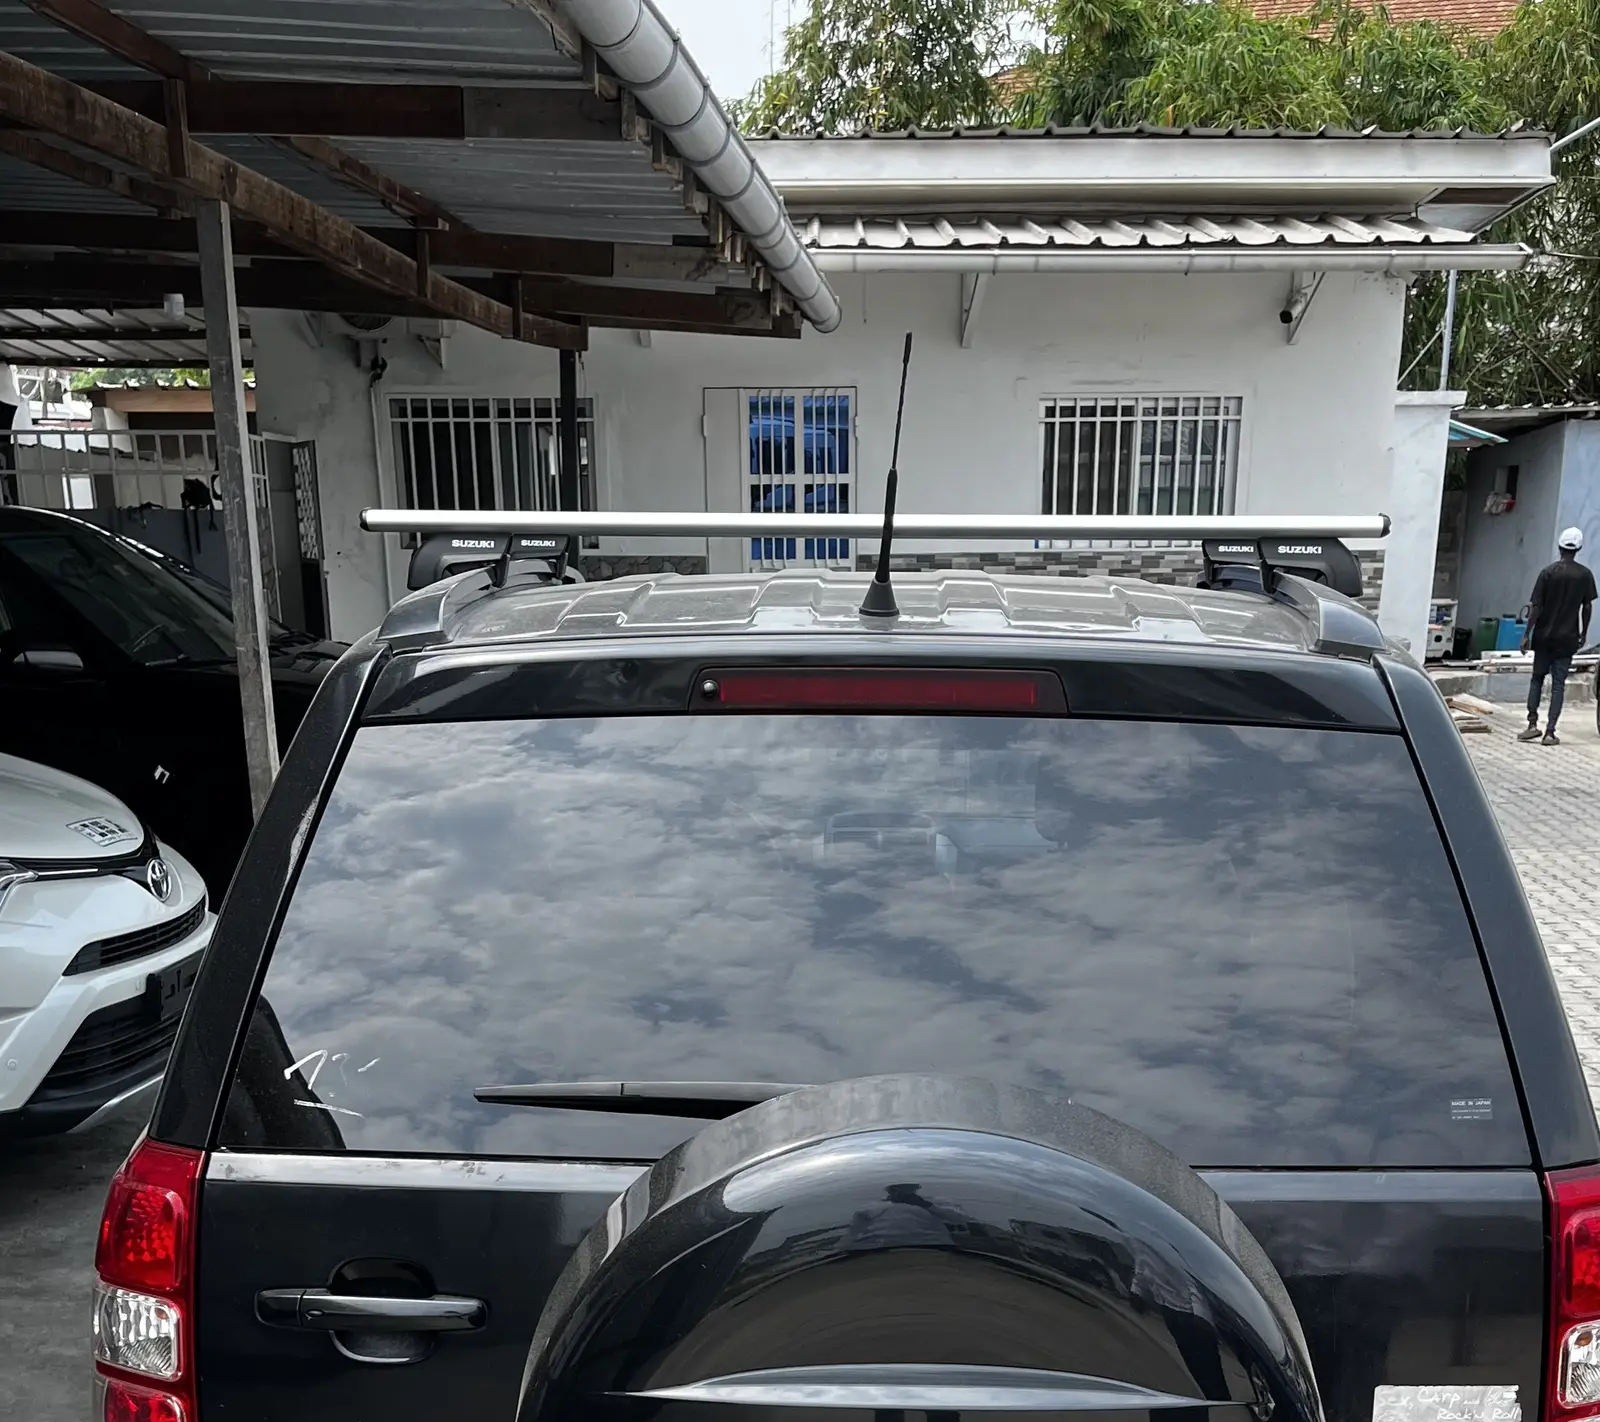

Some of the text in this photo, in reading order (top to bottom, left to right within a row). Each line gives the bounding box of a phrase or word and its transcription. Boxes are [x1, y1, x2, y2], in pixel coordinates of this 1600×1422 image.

[452, 539, 495, 548] SUZUKI
[521, 539, 556, 547] SUZUKI
[1218, 545, 1254, 553] SUZUKI
[1278, 545, 1322, 554] SUZUKI
[1492, 1407, 1518, 1421] Roll
